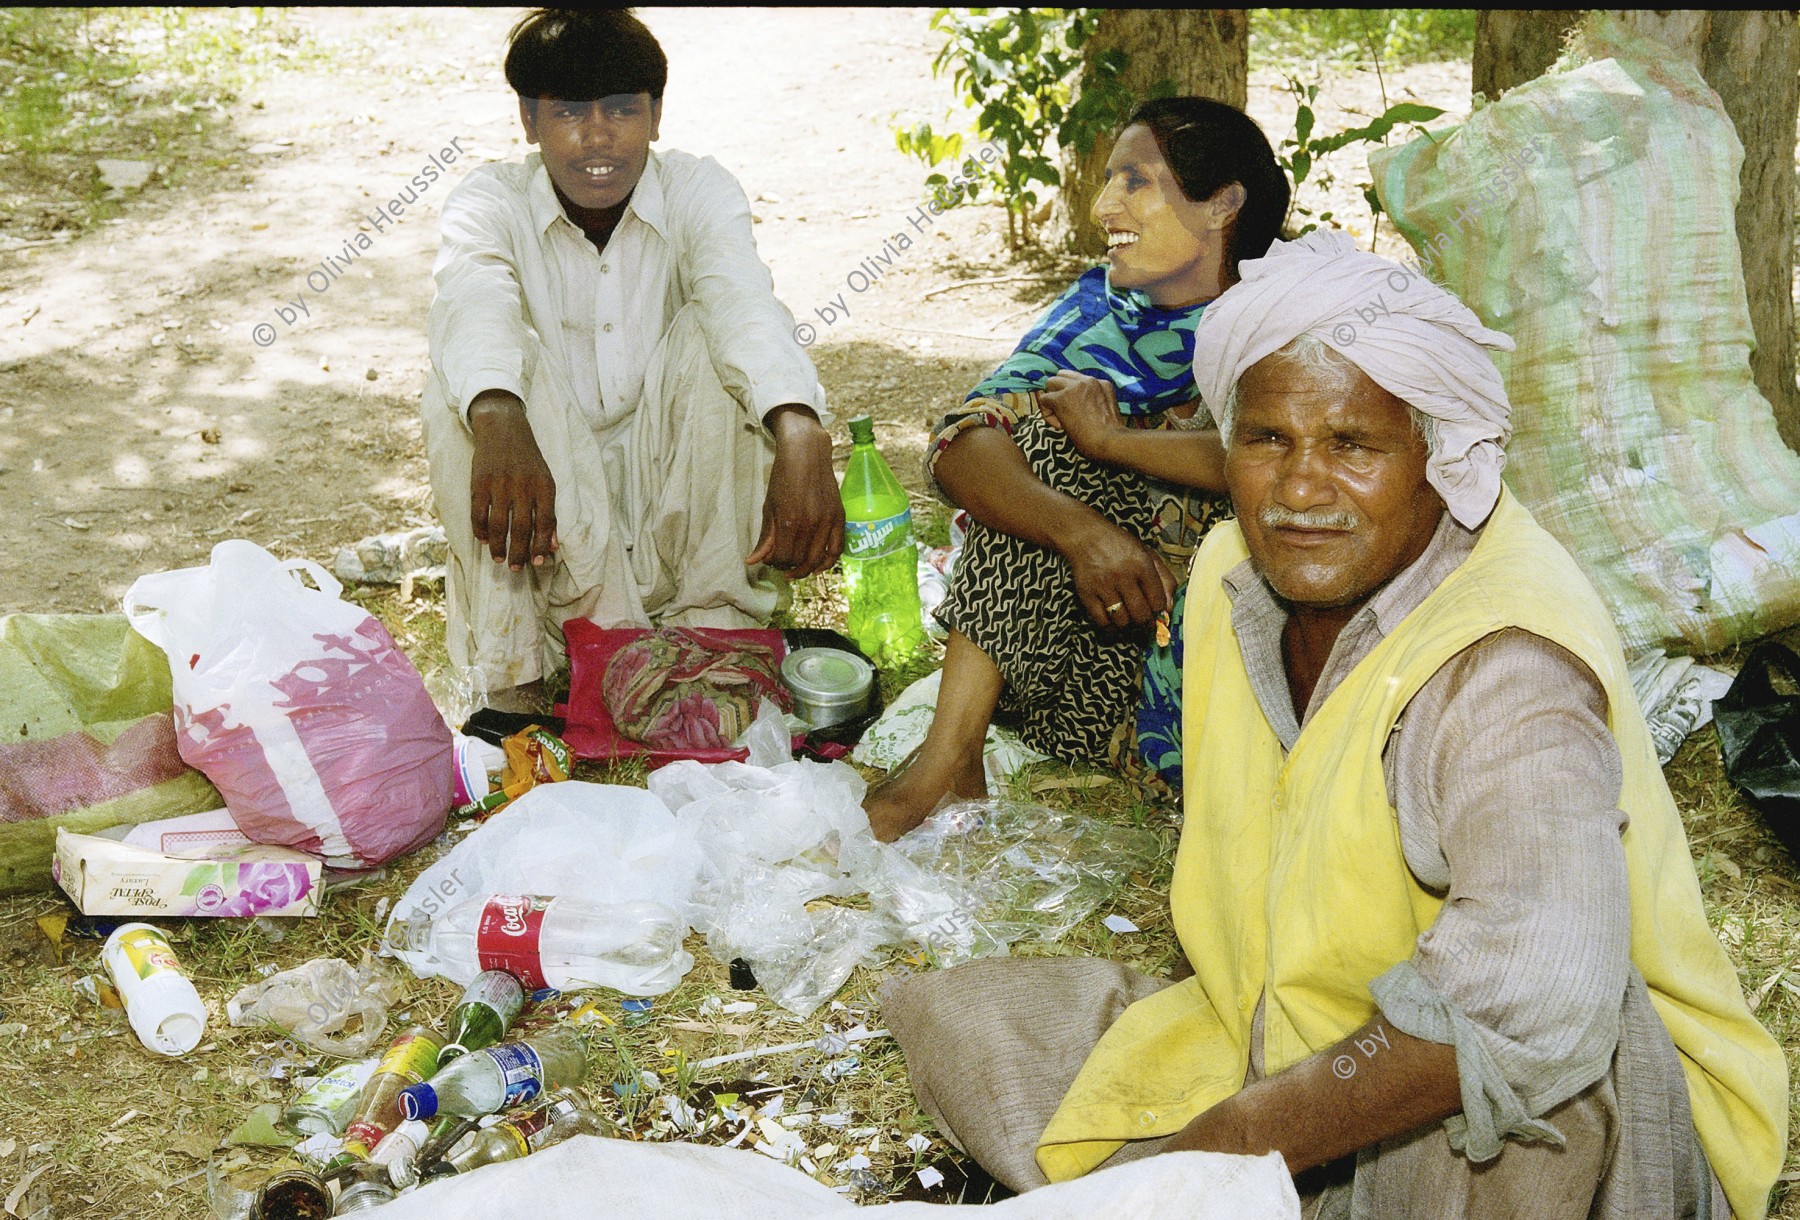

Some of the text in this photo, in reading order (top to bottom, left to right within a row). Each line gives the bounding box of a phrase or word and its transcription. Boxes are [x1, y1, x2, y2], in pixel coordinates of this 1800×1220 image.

[109, 887, 153, 900] PETAL
[127, 894, 168, 910] ROSE
[322, 1077, 356, 1089] Dettol
